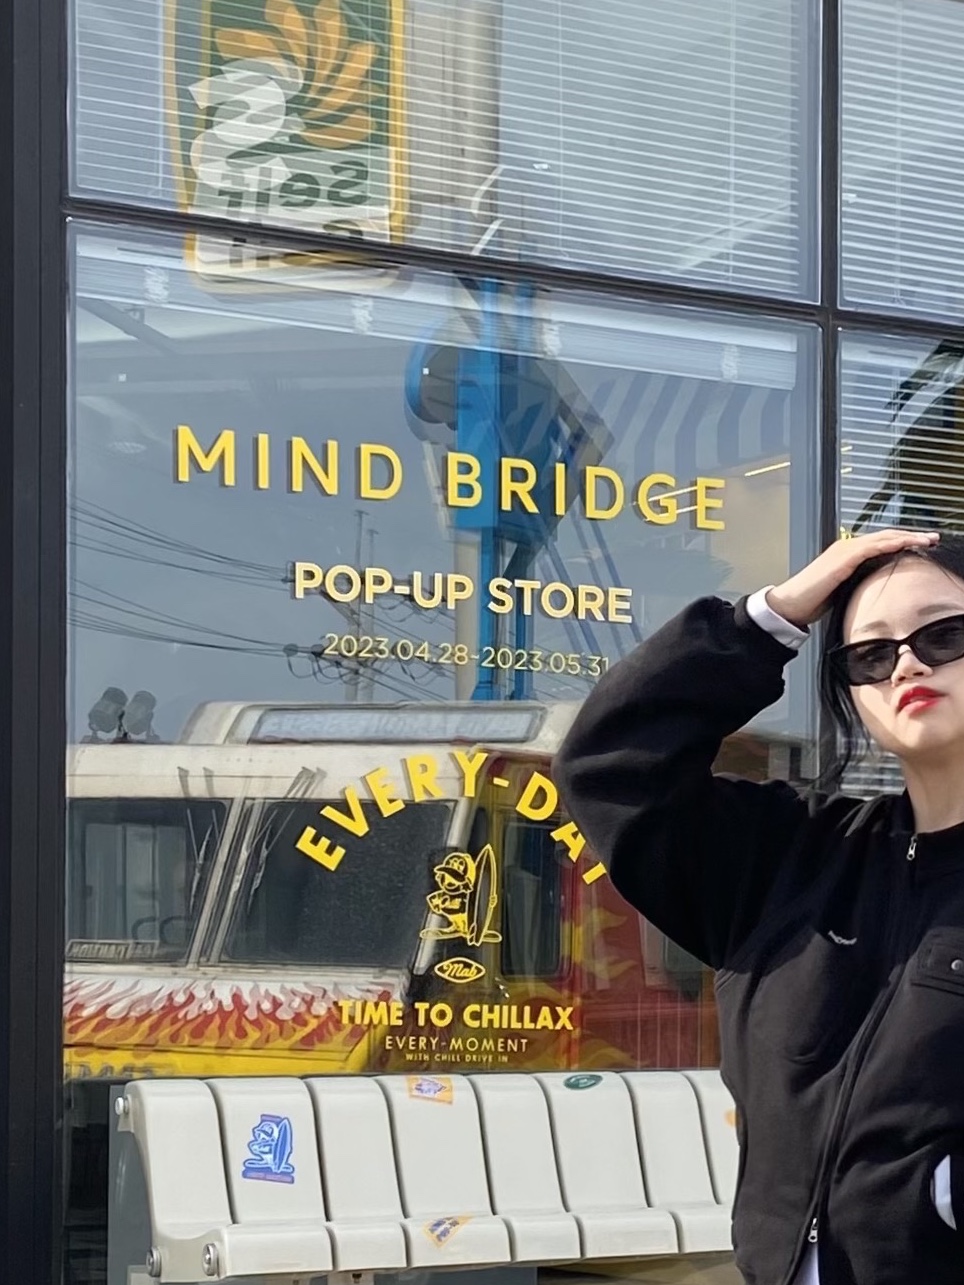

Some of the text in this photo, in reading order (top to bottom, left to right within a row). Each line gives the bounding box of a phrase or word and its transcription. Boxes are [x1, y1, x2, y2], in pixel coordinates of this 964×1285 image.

[174, 424, 727, 530] MIND BRIDGE
[293, 561, 633, 623] POP-UP STORE
[443, 962, 478, 979] Mab
[338, 1000, 575, 1031] TIME TO CHILLAX
[384, 1034, 528, 1054] EVERY-MOMENT
[405, 1052, 508, 1063] WITH CHILL DRIVE IN
